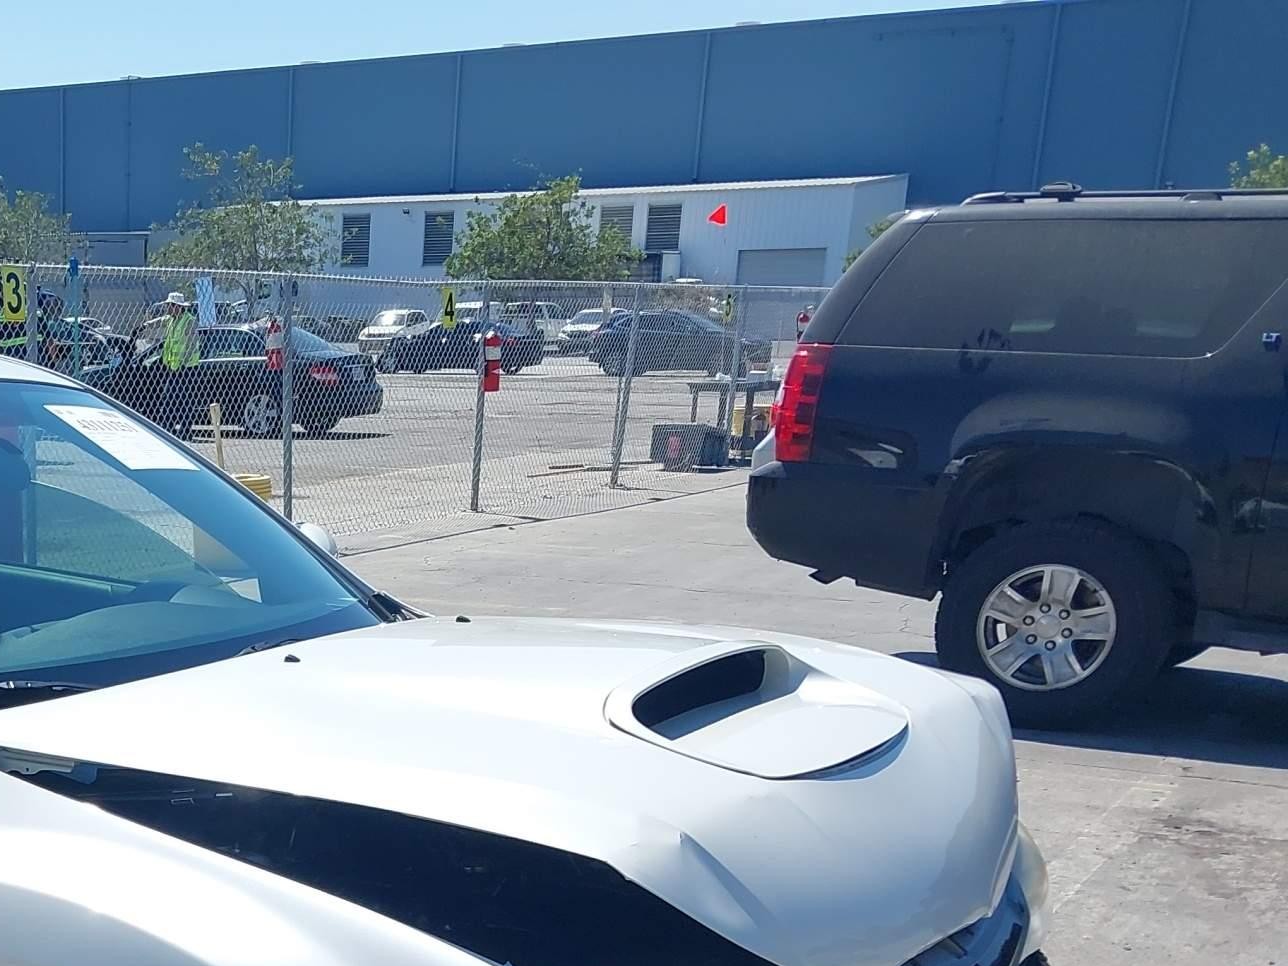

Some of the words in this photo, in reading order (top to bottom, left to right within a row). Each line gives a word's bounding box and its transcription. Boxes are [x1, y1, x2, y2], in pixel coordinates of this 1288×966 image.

[5, 271, 23, 315] 3
[444, 291, 455, 323] 4
[1261, 332, 1281, 342] LT
